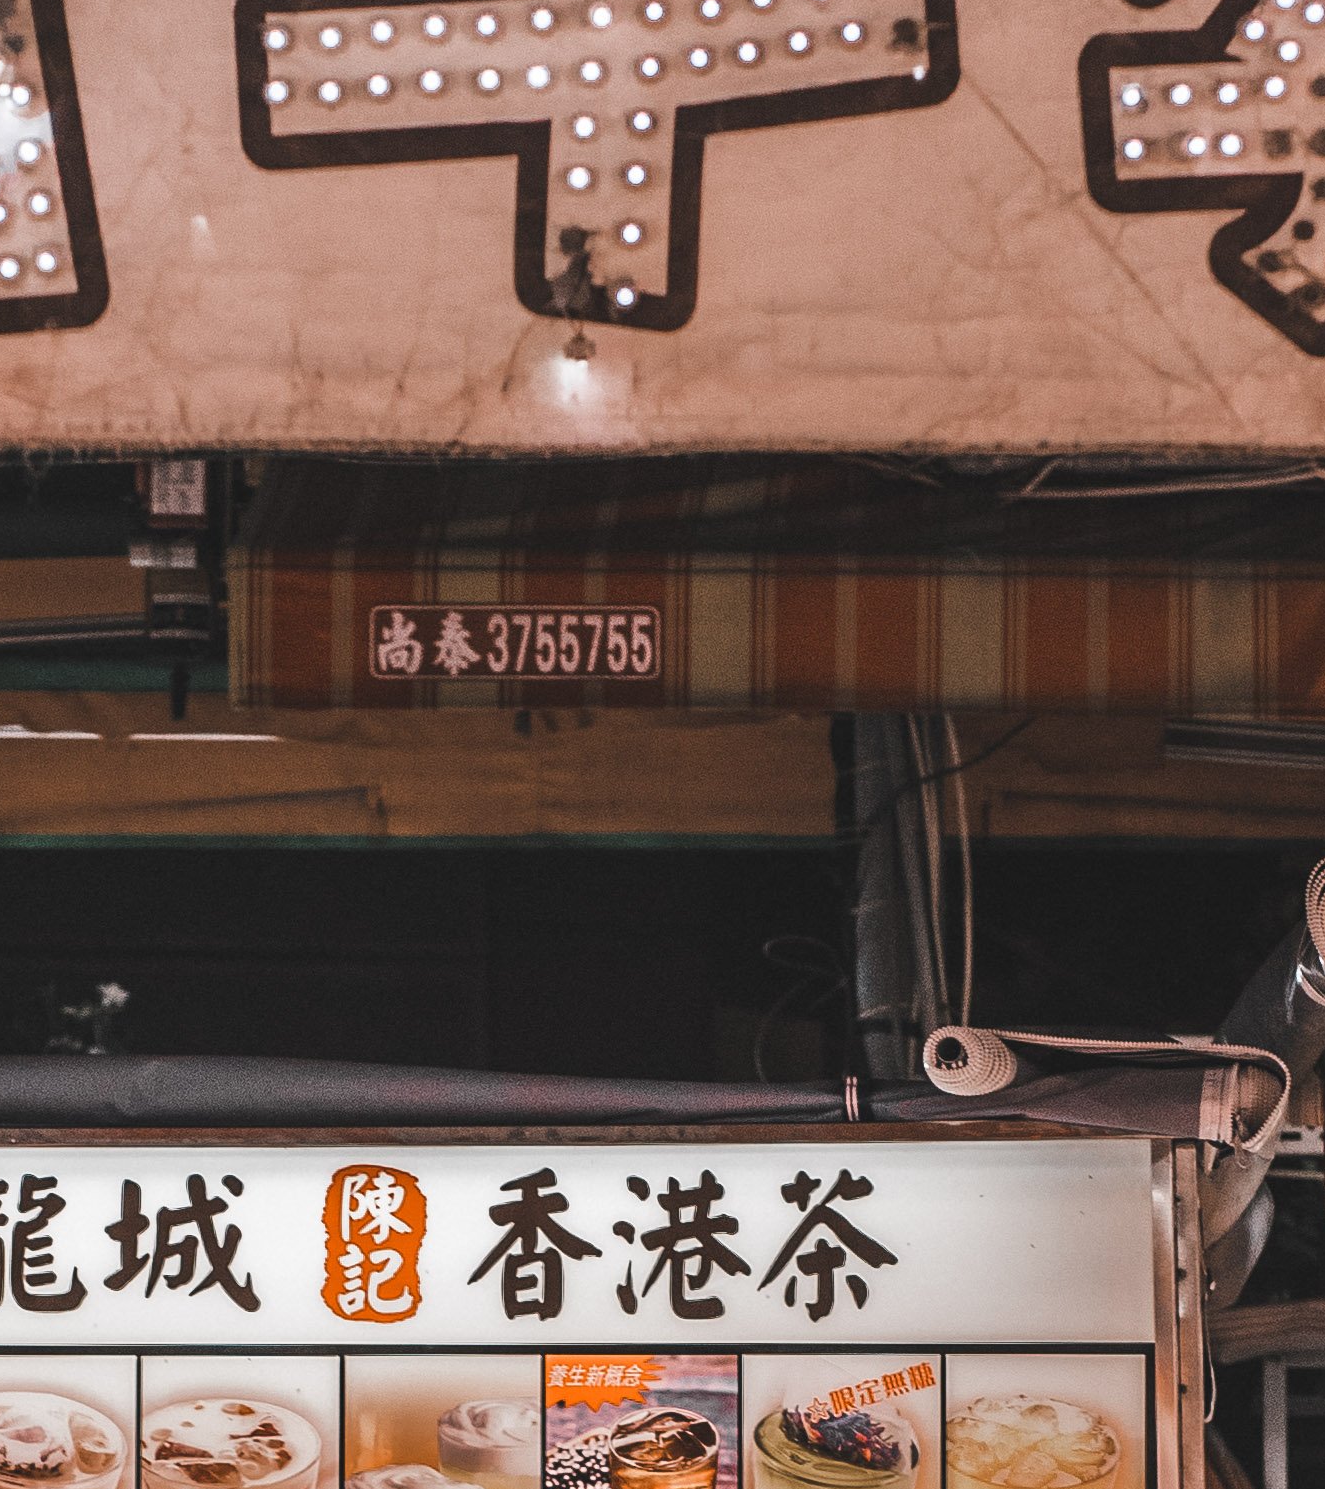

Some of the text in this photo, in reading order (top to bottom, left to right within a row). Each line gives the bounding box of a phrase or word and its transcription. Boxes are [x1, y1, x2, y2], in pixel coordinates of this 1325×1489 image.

[486, 614, 654, 673] 3755755
[338, 1170, 413, 1318] 陳記
[466, 1167, 899, 1322] 香港茶
[547, 1362, 643, 1388] 養生新概念
